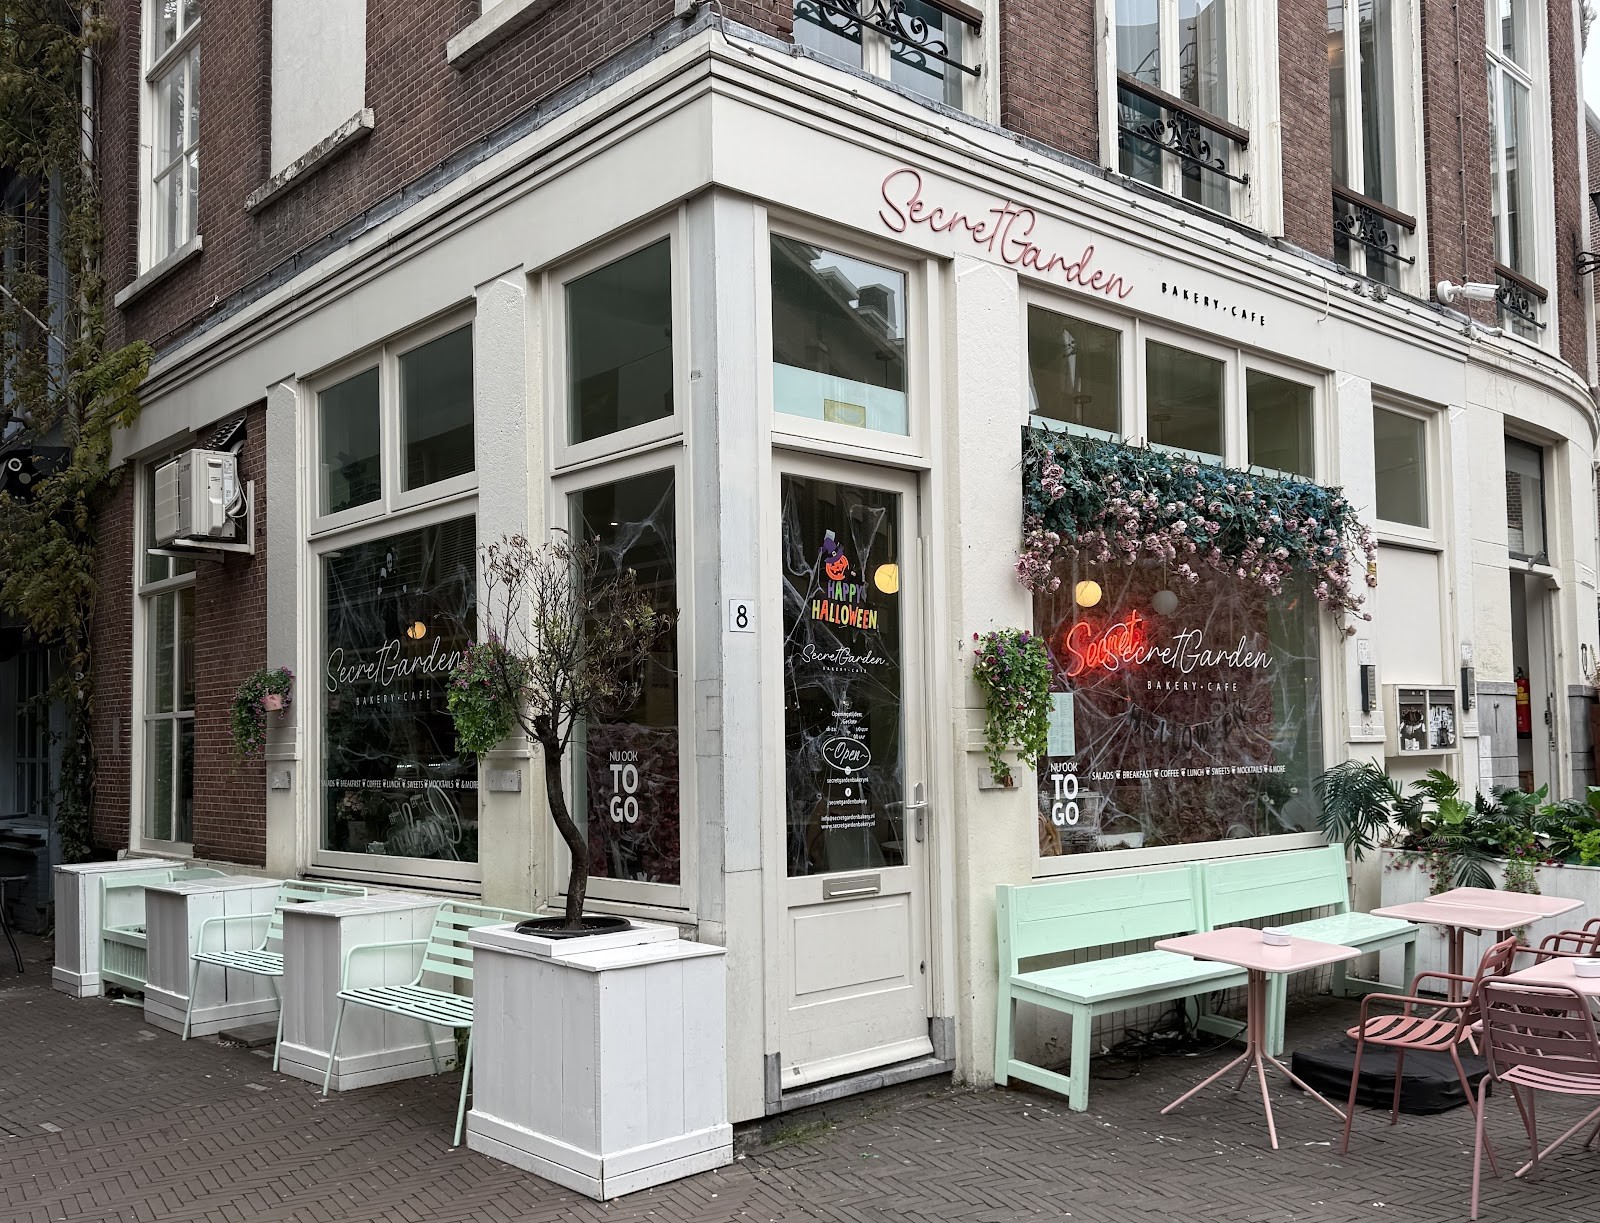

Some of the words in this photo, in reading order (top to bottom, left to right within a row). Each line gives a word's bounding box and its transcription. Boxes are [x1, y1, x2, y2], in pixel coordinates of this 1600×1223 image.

[827, 580, 863, 604] HAPPY
[736, 604, 748, 629] 8
[811, 599, 878, 630] HALLOWEEN
[609, 751, 621, 762] NU
[621, 750, 639, 762] OOK
[834, 742, 861, 765] Open
[609, 764, 639, 794] TO
[1050, 763, 1061, 773] NU
[1062, 762, 1079, 772] OOK
[1092, 771, 1114, 781] SALADS
[1122, 769, 1152, 779] BREAKFAST
[1160, 769, 1180, 778] COFFEE
[1187, 768, 1205, 777] LUNCH
[1211, 766, 1230, 776] SWEETS
[1236, 765, 1263, 775] MOCKTAILS
[340, 779, 361, 788] BREAKFAST
[366, 780, 382, 788] COFFEE
[386, 779, 400, 788] LUNCH
[407, 780, 424, 789] SWEETS
[428, 779, 454, 789] MOCKTAILS
[1051, 774, 1079, 800] TO
[609, 795, 639, 824] GO
[1051, 801, 1080, 826] GO
